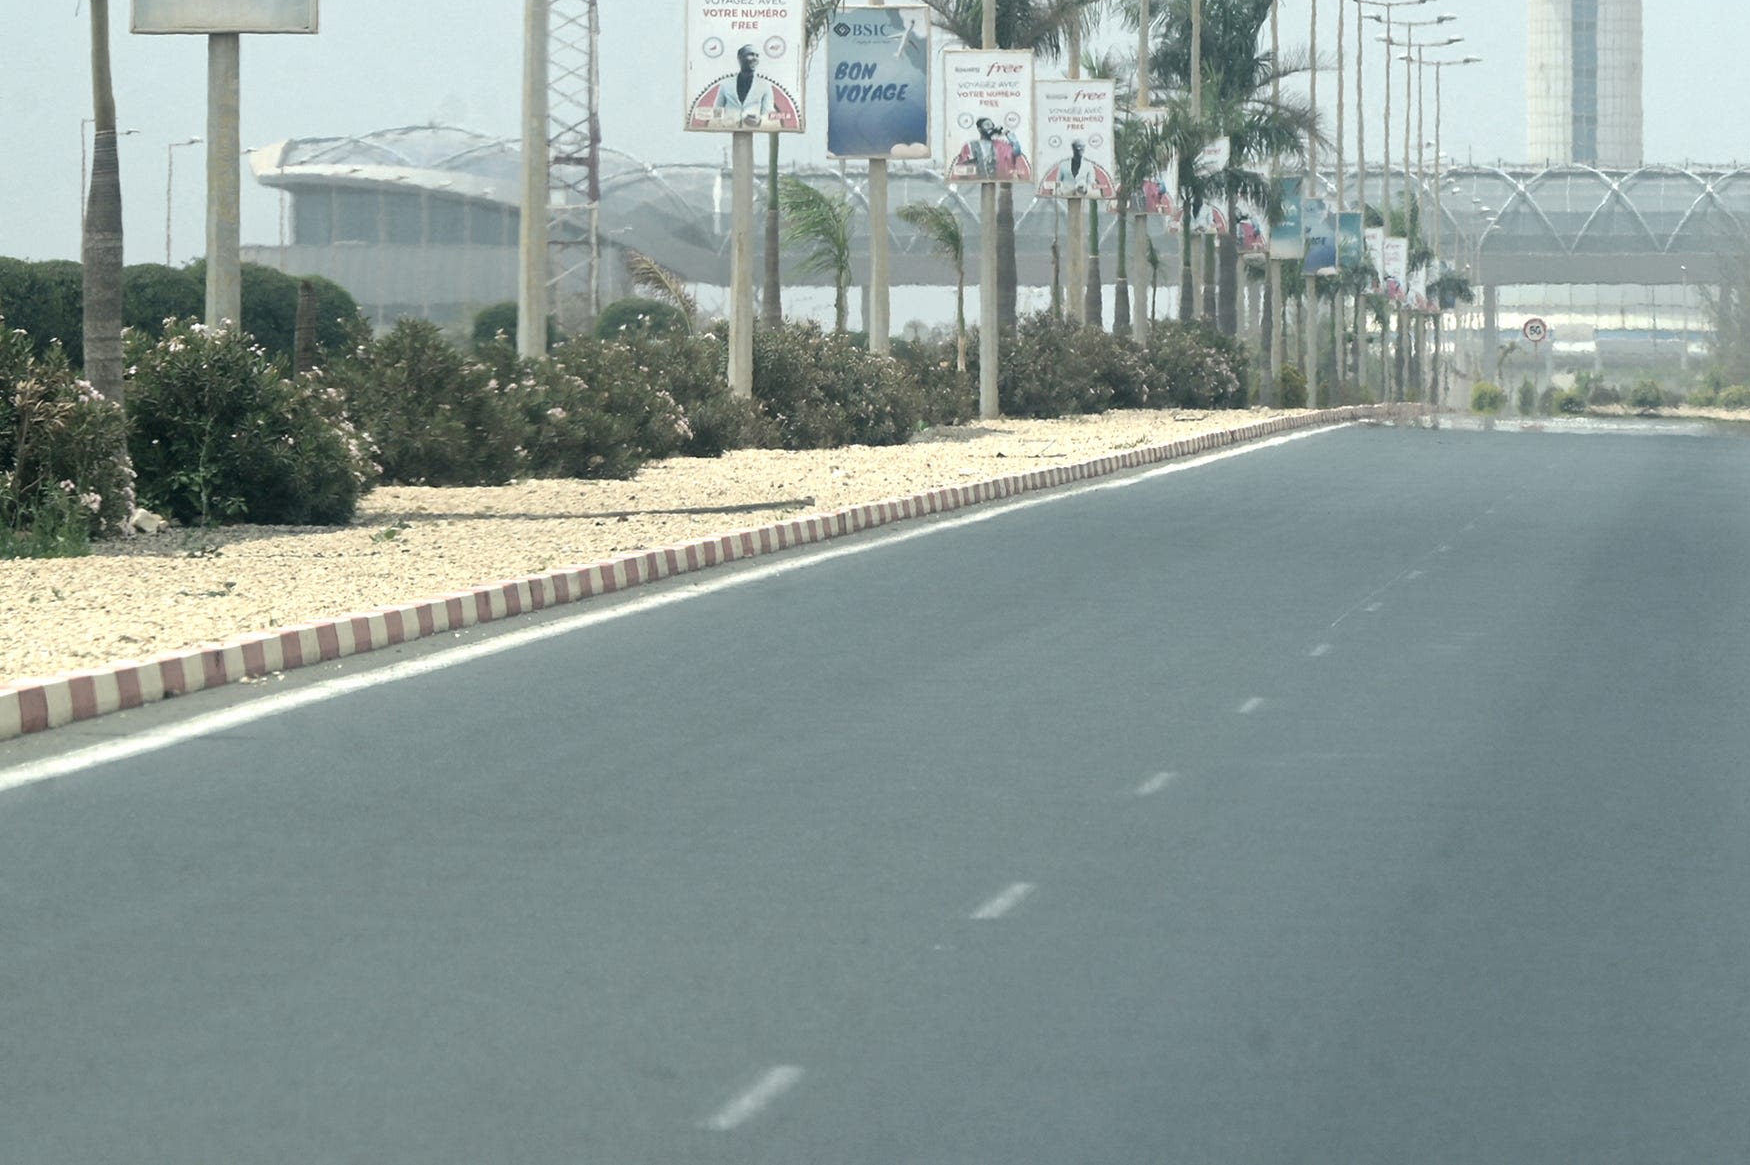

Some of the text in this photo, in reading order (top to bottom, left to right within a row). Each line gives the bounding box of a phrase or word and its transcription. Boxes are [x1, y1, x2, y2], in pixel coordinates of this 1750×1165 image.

[703, 7, 788, 18] VOTRE NUMÉRO
[731, 21, 759, 30] FREE
[853, 23, 889, 37] BSIC
[834, 61, 877, 81] BON
[987, 62, 1023, 77] free
[835, 83, 908, 103] VOYAGE
[1073, 89, 1106, 104] free
[1530, 325, 1541, 336] 50
